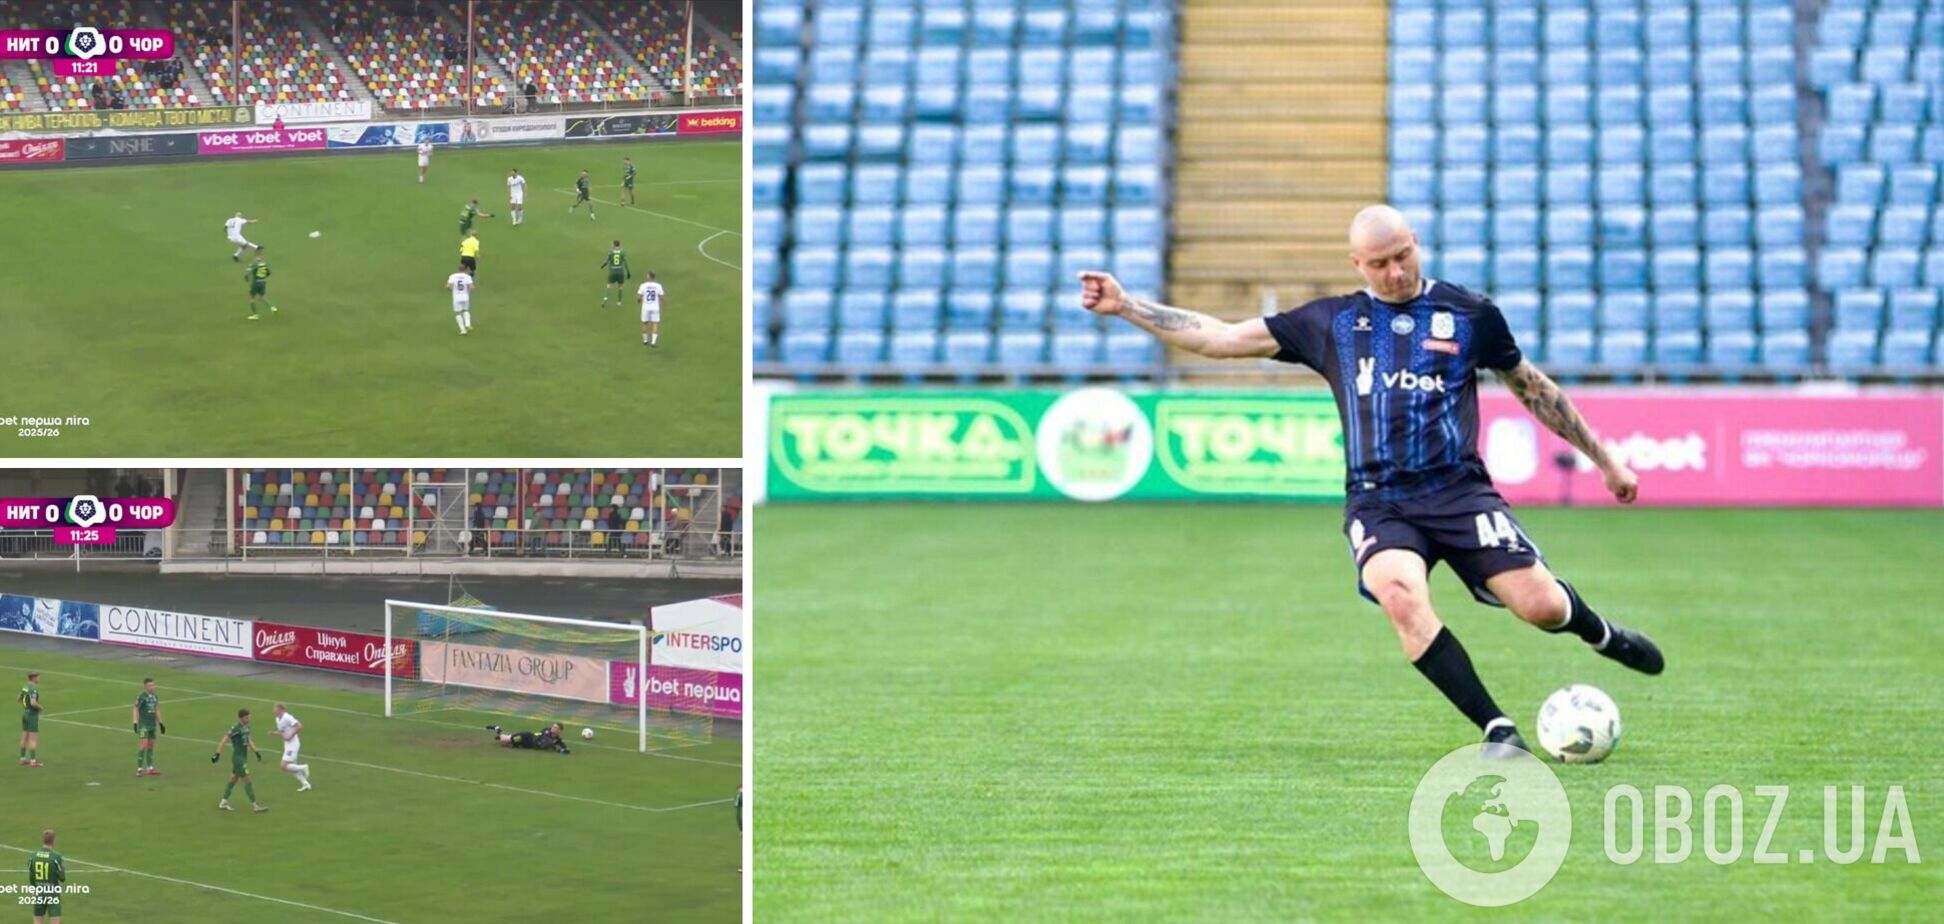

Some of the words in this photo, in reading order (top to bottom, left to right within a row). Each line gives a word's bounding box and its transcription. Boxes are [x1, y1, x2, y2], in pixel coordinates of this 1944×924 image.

[262, 101, 367, 120] CONTINENT
[701, 116, 737, 129] betking
[202, 133, 239, 146] vbet
[244, 131, 281, 144] vbet
[288, 129, 323, 143] vbet
[1382, 369, 1446, 393] vbet
[1475, 511, 1520, 547] 44
[108, 607, 244, 645] CONTINENT
[316, 631, 347, 649] Цінуй
[665, 631, 743, 654] INTERSPO
[452, 648, 513, 674] FANTAZIA
[518, 656, 574, 684] GROUP
[684, 682, 740, 704] перша
[35, 861, 49, 880] 91
